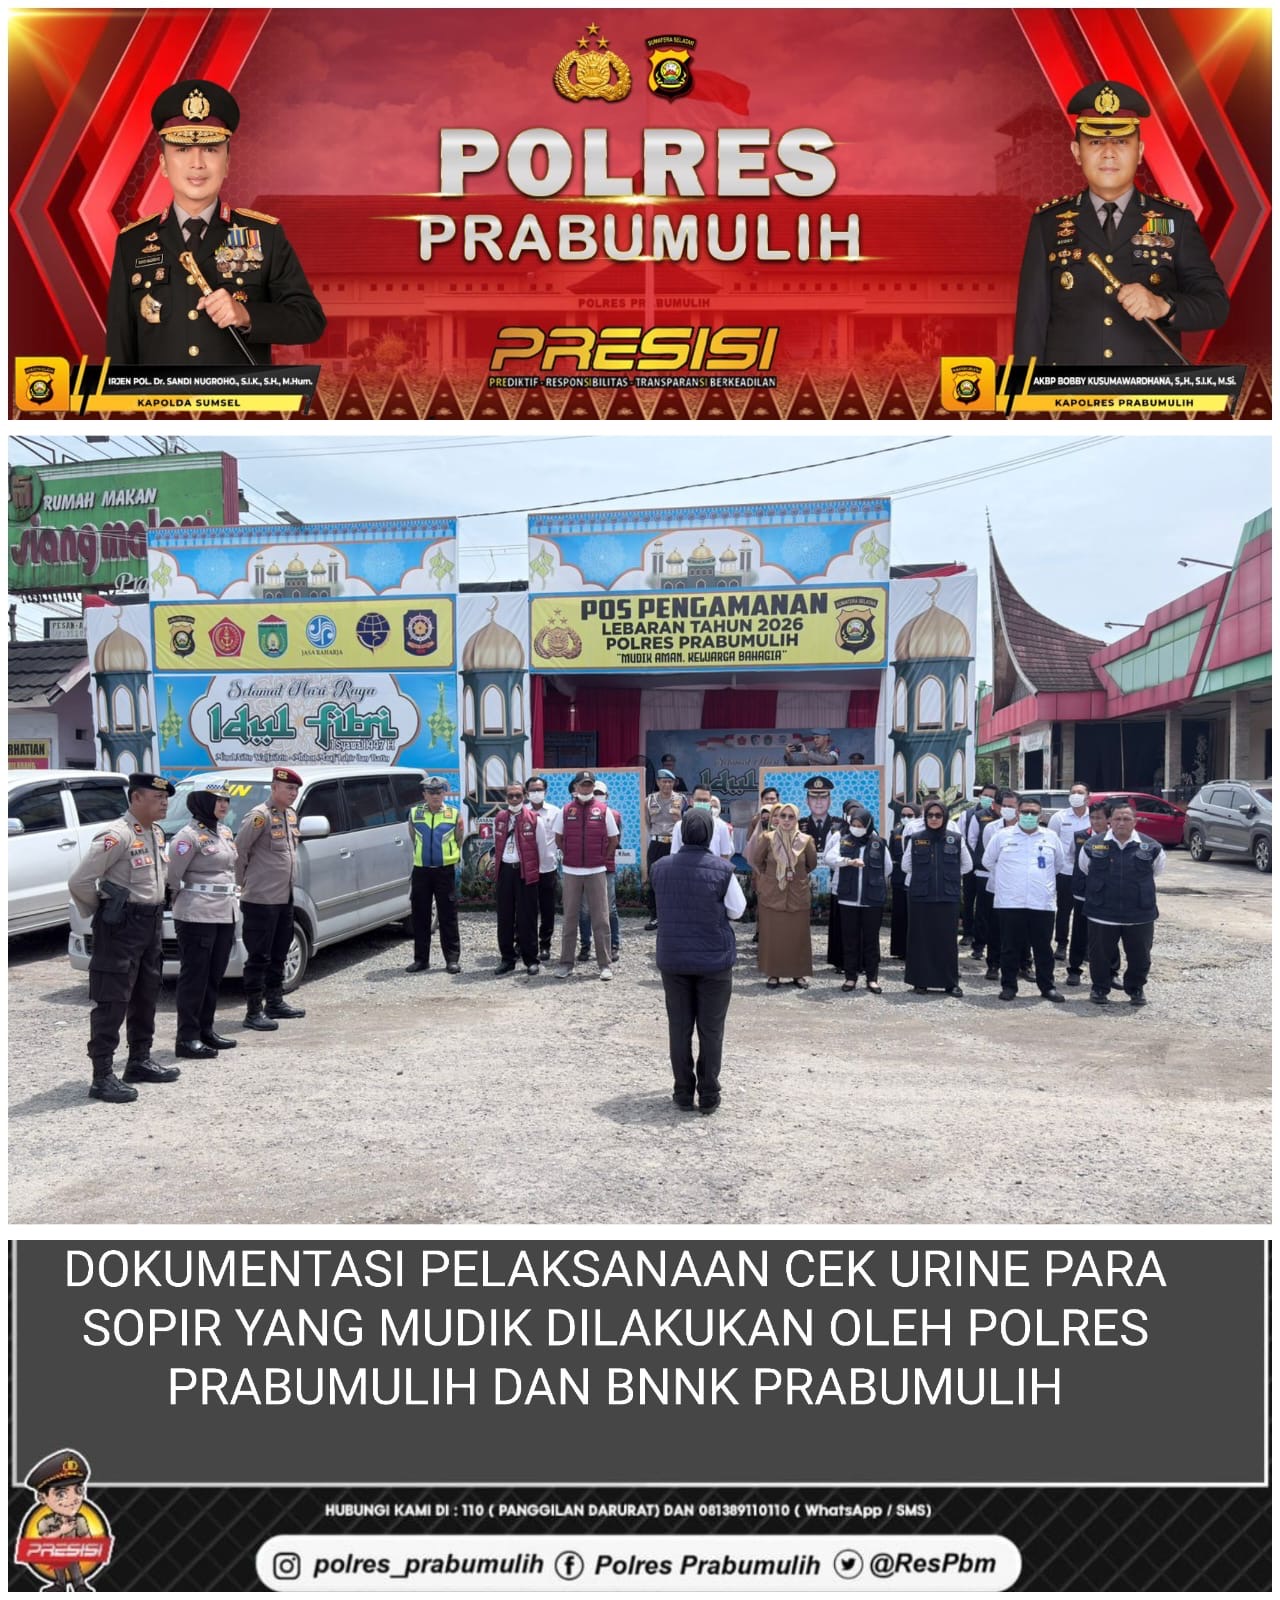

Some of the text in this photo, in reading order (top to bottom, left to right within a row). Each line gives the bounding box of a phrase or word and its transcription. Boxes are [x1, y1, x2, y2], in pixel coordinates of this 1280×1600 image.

[578, 298, 710, 308] POLRES PRBUMULIH
[43, 488, 157, 511] RUMAH MAKAN
[581, 599, 631, 620] POS
[638, 593, 828, 619] PENGAMANAN
[602, 617, 804, 635] LEBARAN TAHUN 2026
[606, 633, 799, 650] POLRES PRABUMULIH
[688, 651, 735, 663] KELUARGA
[227, 679, 377, 702] Selamat Hari Raya
